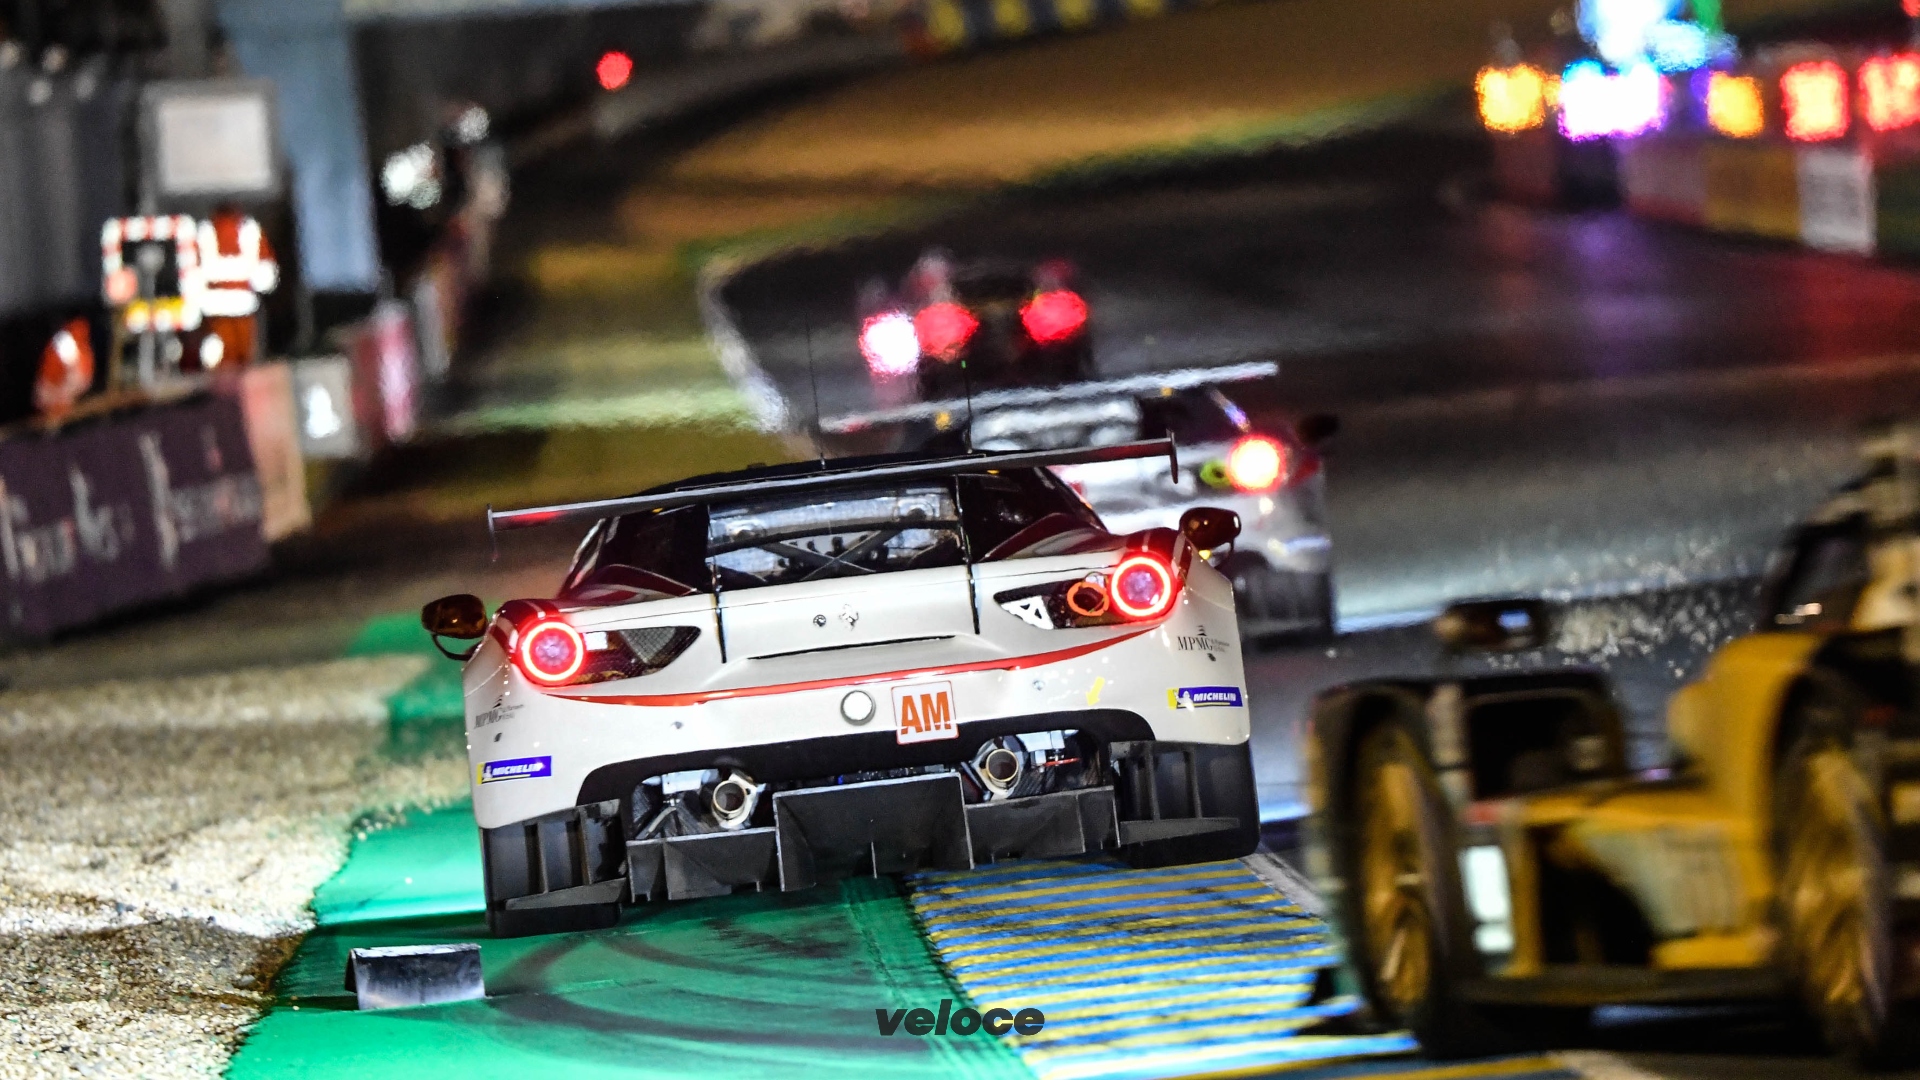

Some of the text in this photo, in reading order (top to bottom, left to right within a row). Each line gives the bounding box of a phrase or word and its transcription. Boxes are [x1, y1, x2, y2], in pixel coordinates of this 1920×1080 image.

[1177, 636, 1213, 651] MPMG
[1193, 692, 1237, 702] MICHELIN
[900, 691, 952, 735] AM
